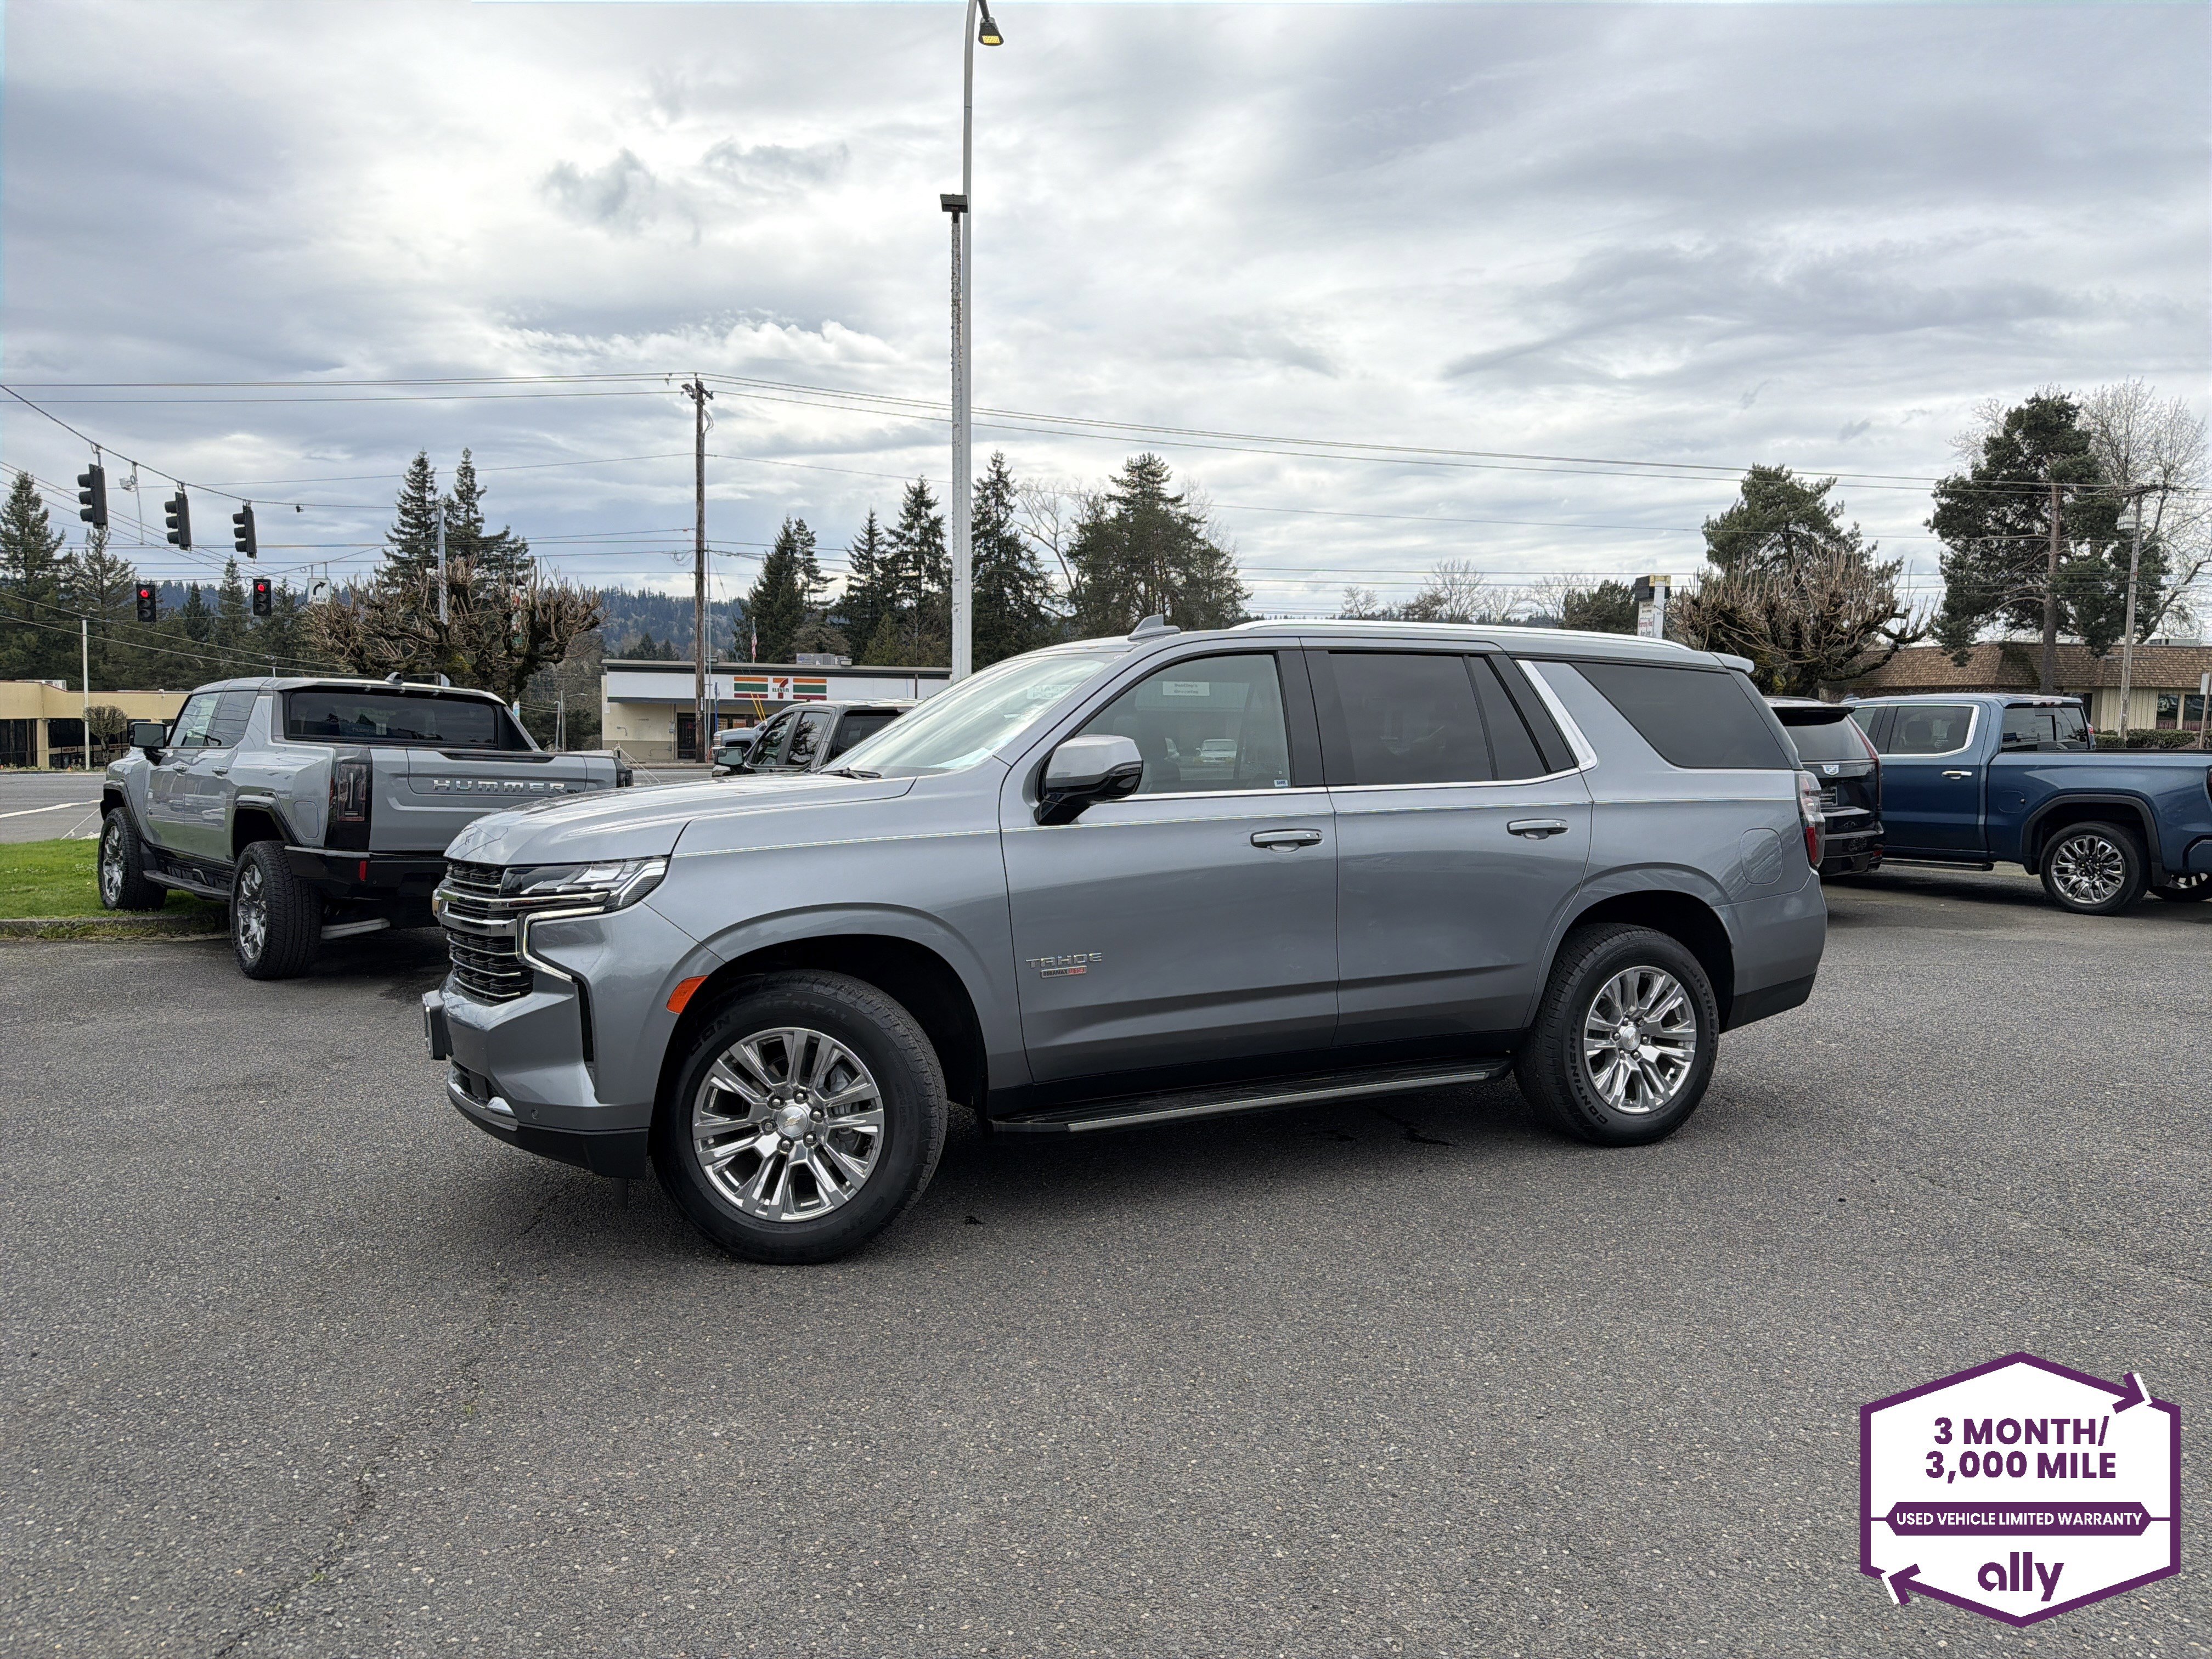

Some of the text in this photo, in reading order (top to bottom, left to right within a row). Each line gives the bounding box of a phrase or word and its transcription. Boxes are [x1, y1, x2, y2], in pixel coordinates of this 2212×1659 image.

[772, 678, 789, 699] 7
[433, 779, 566, 793] HUMMER
[1025, 952, 1103, 969] TAHOE
